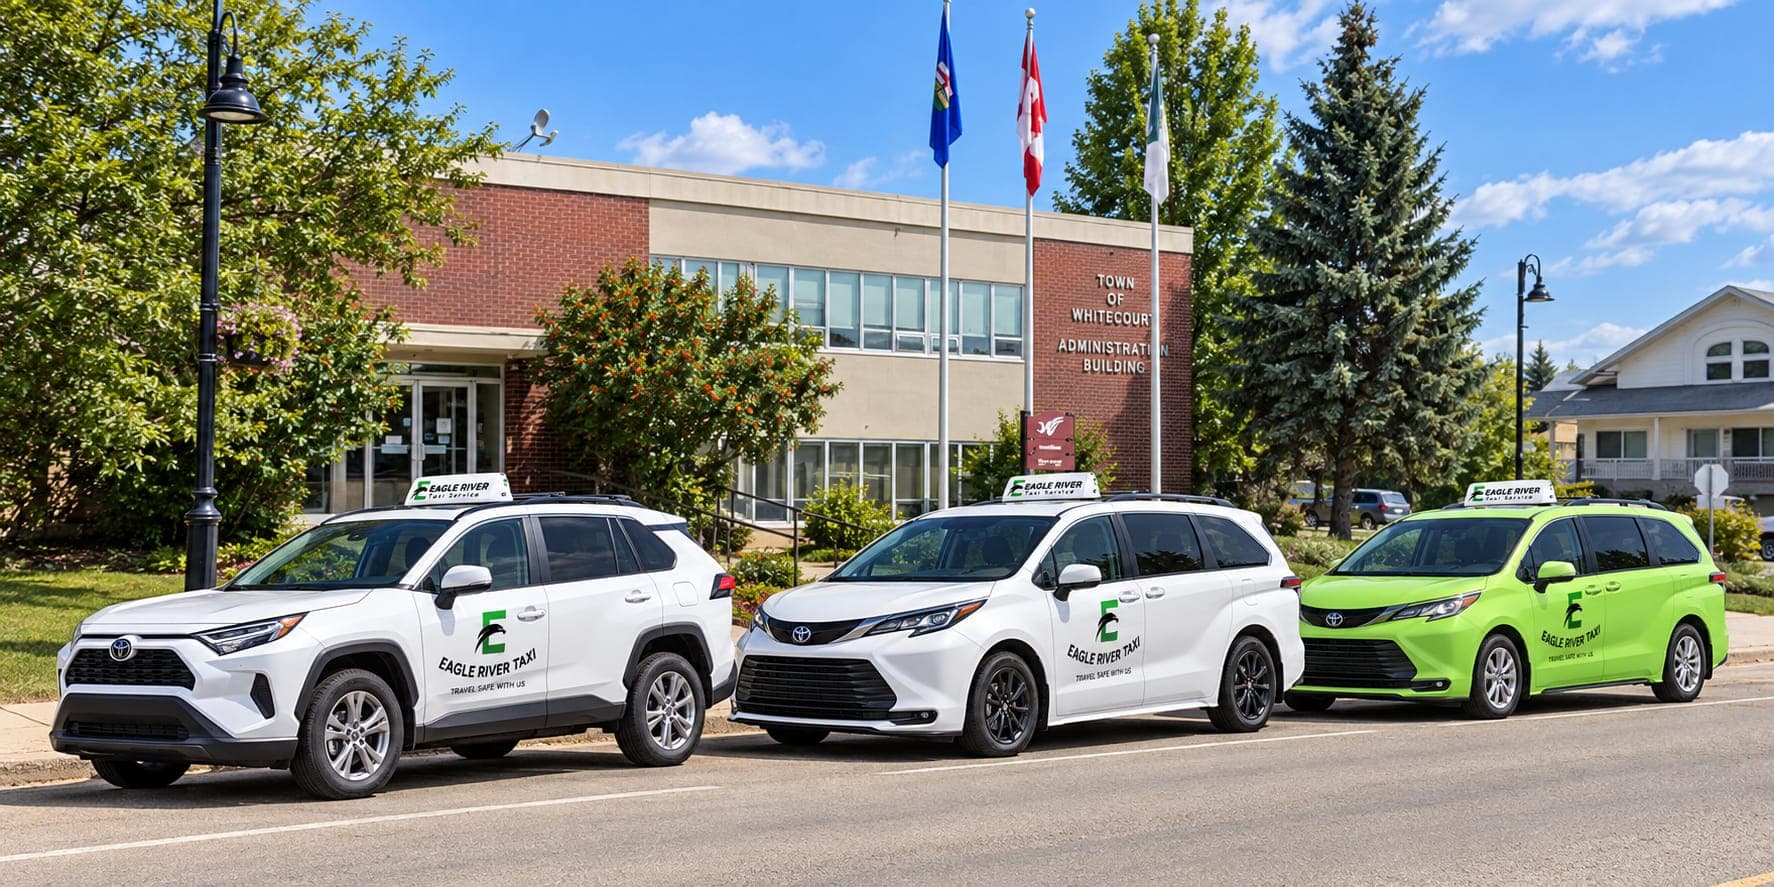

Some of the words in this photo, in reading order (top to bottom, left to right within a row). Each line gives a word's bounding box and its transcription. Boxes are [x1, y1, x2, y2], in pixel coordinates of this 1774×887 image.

[1097, 274, 1135, 289] TOWN
[1107, 293, 1125, 306] OF
[1058, 338, 1169, 356] ADMINISTRATIN
[1083, 358, 1145, 374] BUILDING
[428, 483, 460, 493] EAGLE
[459, 482, 490, 492] RIVER
[1024, 482, 1054, 491] EAGLE
[1054, 480, 1083, 490] RIVER
[1484, 488, 1513, 497] EAGLE
[1513, 486, 1541, 495] RIVER
[1541, 630, 1565, 648] EAGLE
[1564, 635, 1585, 648] RIVER
[1585, 624, 1601, 642] TAXI
[1067, 643, 1096, 665] EAGLE
[1096, 649, 1121, 665] RIVER
[1122, 635, 1141, 657] TAXI
[438, 656, 476, 678] EAGLE
[477, 662, 510, 678] RIVER
[512, 647, 537, 670] TAXI
[1097, 669, 1110, 679] SAFE
[450, 686, 476, 695] TRAVEL
[478, 683, 495, 692] SAFE
[496, 681, 515, 690] WITH
[516, 680, 526, 688] US
